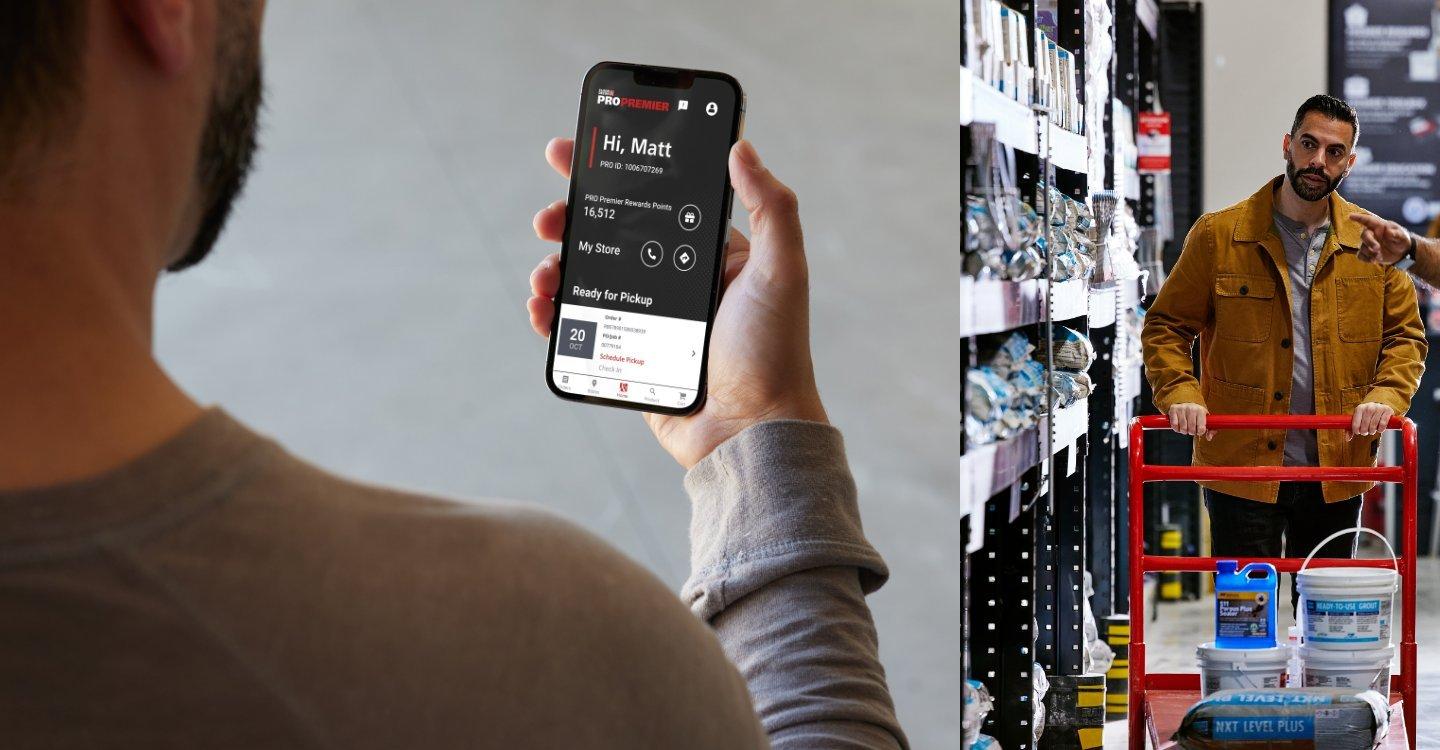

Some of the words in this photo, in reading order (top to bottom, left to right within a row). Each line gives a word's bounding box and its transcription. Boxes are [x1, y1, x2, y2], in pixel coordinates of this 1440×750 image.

[597, 95, 620, 106] PRO
[620, 97, 670, 111] PREMIER
[603, 134, 625, 155] Hi,
[631, 137, 672, 158] Matt
[600, 160, 614, 169] PRO
[614, 161, 623, 170] ID:
[584, 193, 599, 202] PRO
[600, 195, 624, 206] Premier
[625, 198, 651, 209] Rewards
[652, 202, 672, 211] Points
[584, 206, 616, 220] 16,512
[578, 240, 593, 254] My
[595, 242, 621, 256] Store
[572, 285, 602, 301] Ready
[604, 289, 618, 301] for
[620, 291, 653, 308] Pickup
[570, 328, 585, 342] 20
[569, 342, 583, 351] OCT
[599, 353, 625, 363] Schedule
[625, 356, 645, 367] Pickup
[1316, 602, 1356, 611] READY-TO-USE
[1358, 602, 1378, 610] GROUT
[1216, 720, 1239, 733] NXT
[1243, 720, 1274, 733] LEVEL
[1278, 720, 1305, 733] PLUS
